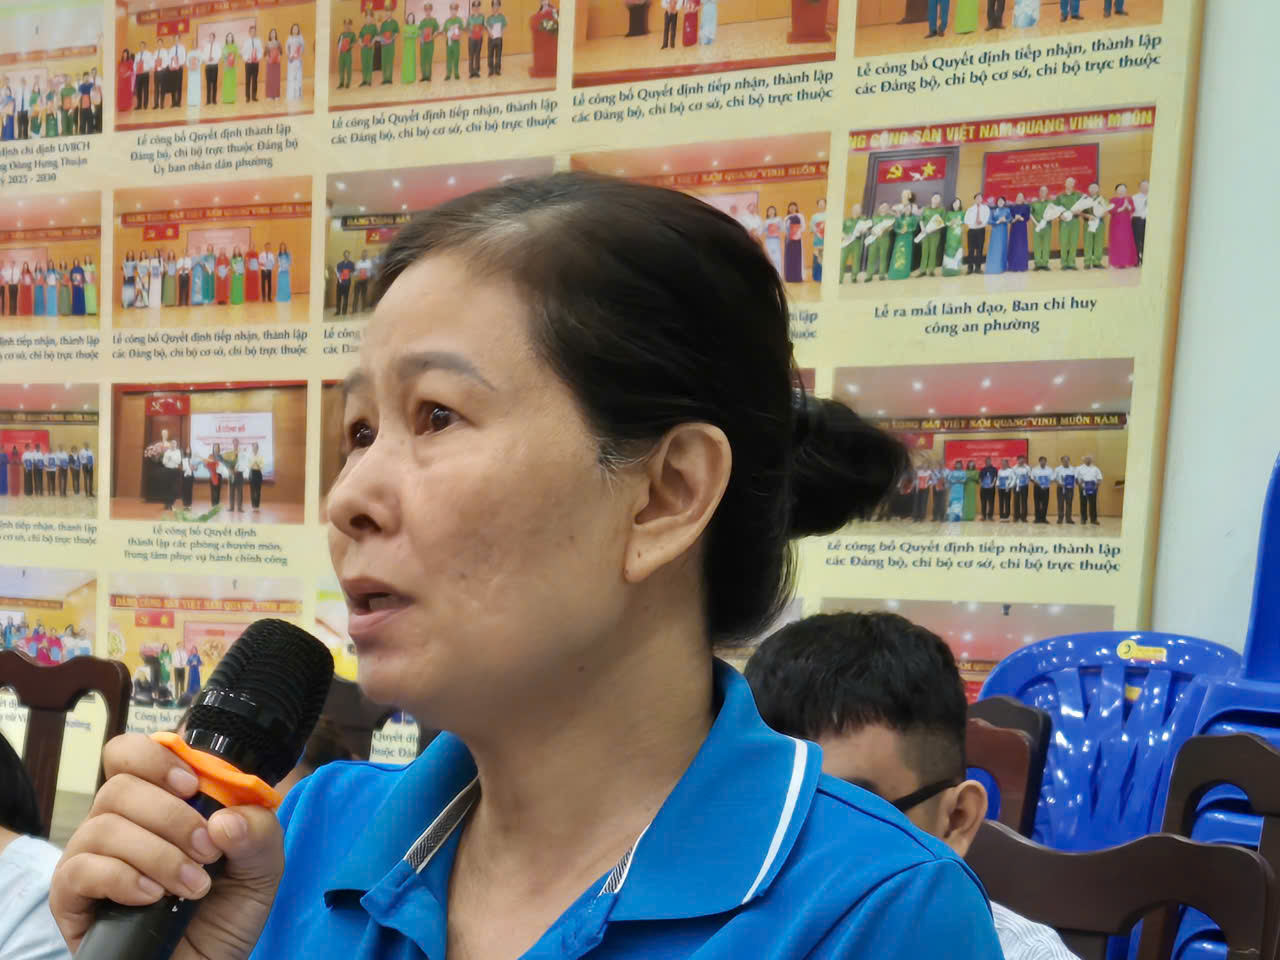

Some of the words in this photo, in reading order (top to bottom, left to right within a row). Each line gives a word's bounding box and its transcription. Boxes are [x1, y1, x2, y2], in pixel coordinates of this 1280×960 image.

[875, 62, 907, 77] công
[911, 54, 928, 72] bố
[932, 50, 974, 71] Quyết
[979, 50, 1010, 67] định
[1015, 43, 1041, 62] tiếp
[1046, 43, 1087, 59] nhận,
[1092, 37, 1133, 53] thành
[1139, 35, 1161, 50] lập
[894, 309, 906, 318] ra
[912, 300, 937, 317] mắt
[942, 302, 971, 315] lãnh
[977, 301, 1007, 316] đạo,
[1013, 300, 1038, 312] Ban
[1044, 294, 1065, 310] chỉ
[1071, 297, 1097, 312] huy
[925, 322, 957, 336] công
[963, 324, 978, 332] an
[984, 318, 1040, 335] phường
